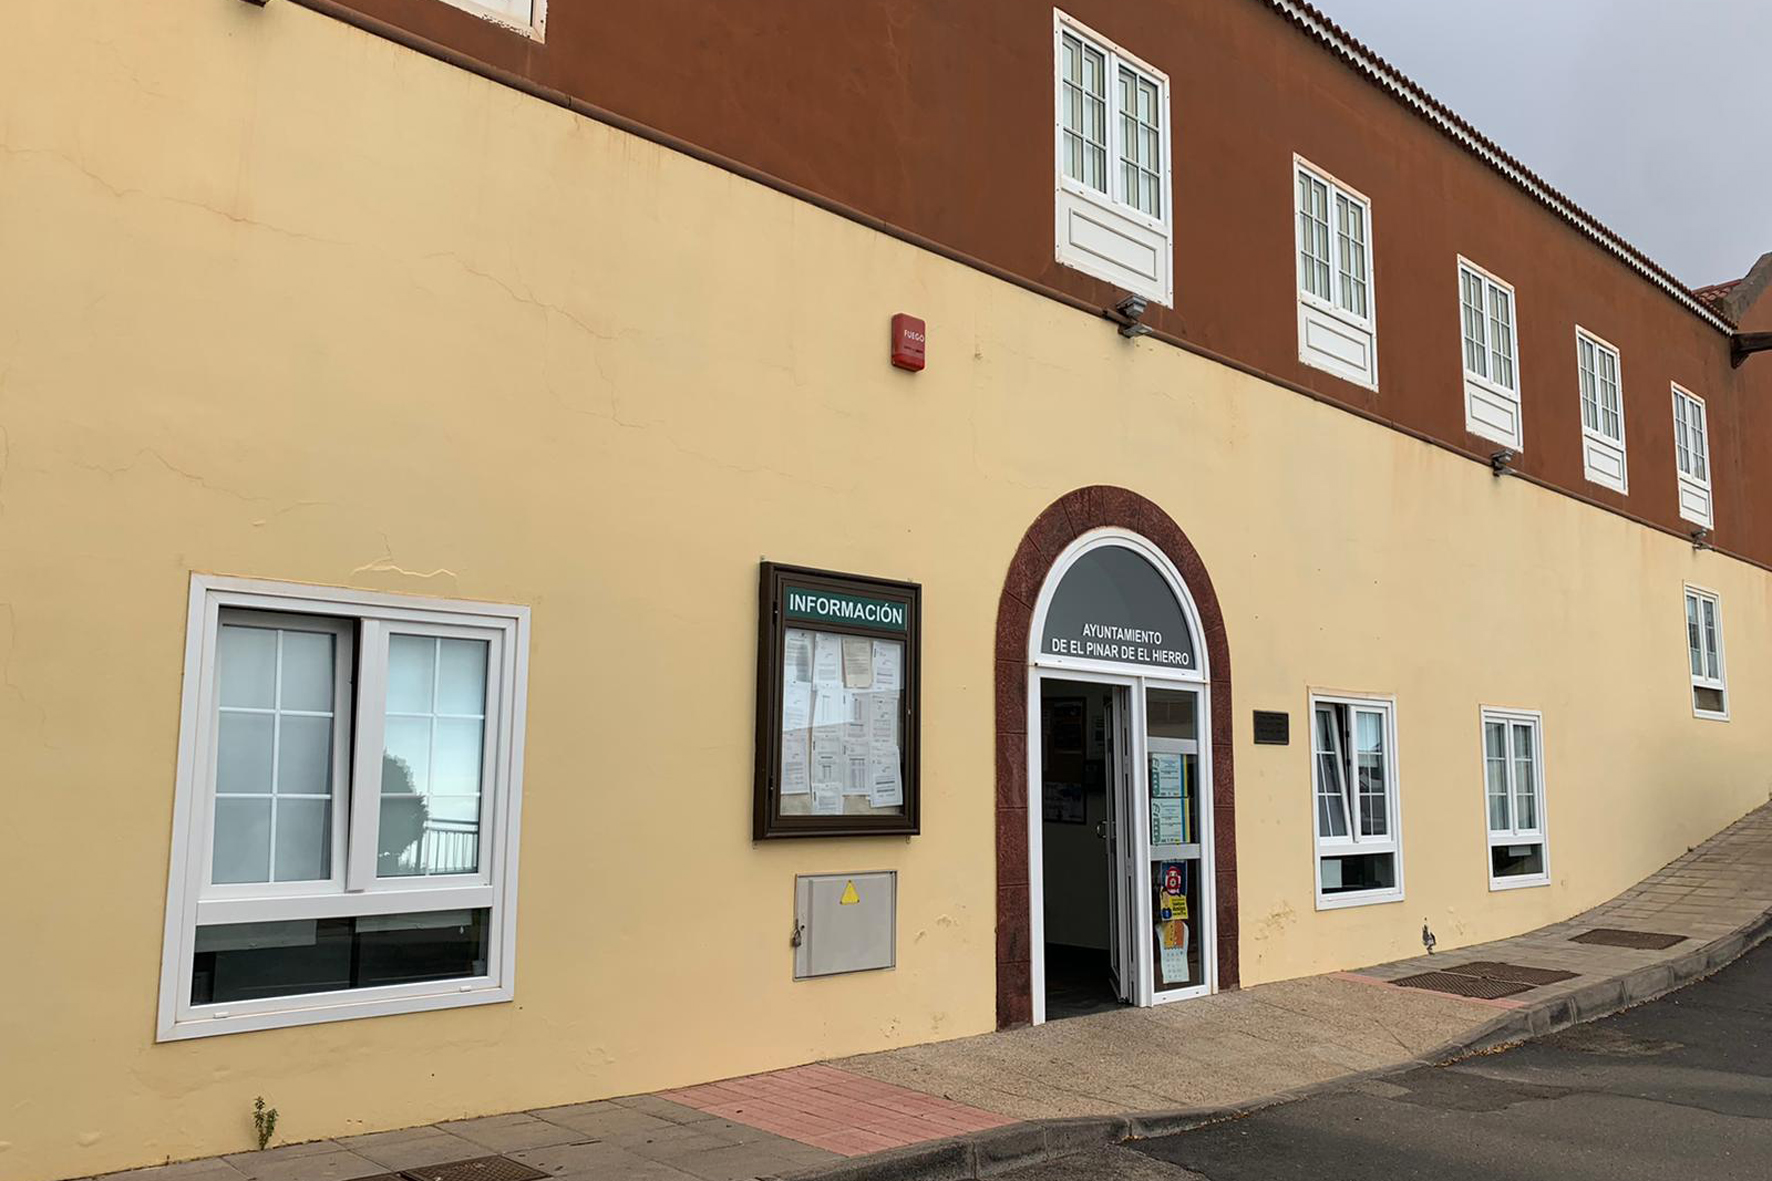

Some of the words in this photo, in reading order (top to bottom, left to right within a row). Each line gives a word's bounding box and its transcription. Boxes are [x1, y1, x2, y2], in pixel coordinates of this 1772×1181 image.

[904, 329, 925, 343] FUEGO
[789, 593, 903, 624] INFORMACIÓN
[1083, 623, 1162, 645] AYUNTAMIENTO
[1052, 638, 1067, 653] DE
[1070, 640, 1084, 655] EL
[1086, 642, 1119, 658] PINAR
[1121, 645, 1135, 660] DE
[1137, 647, 1150, 661] EL
[1152, 649, 1190, 666] HIERRO
